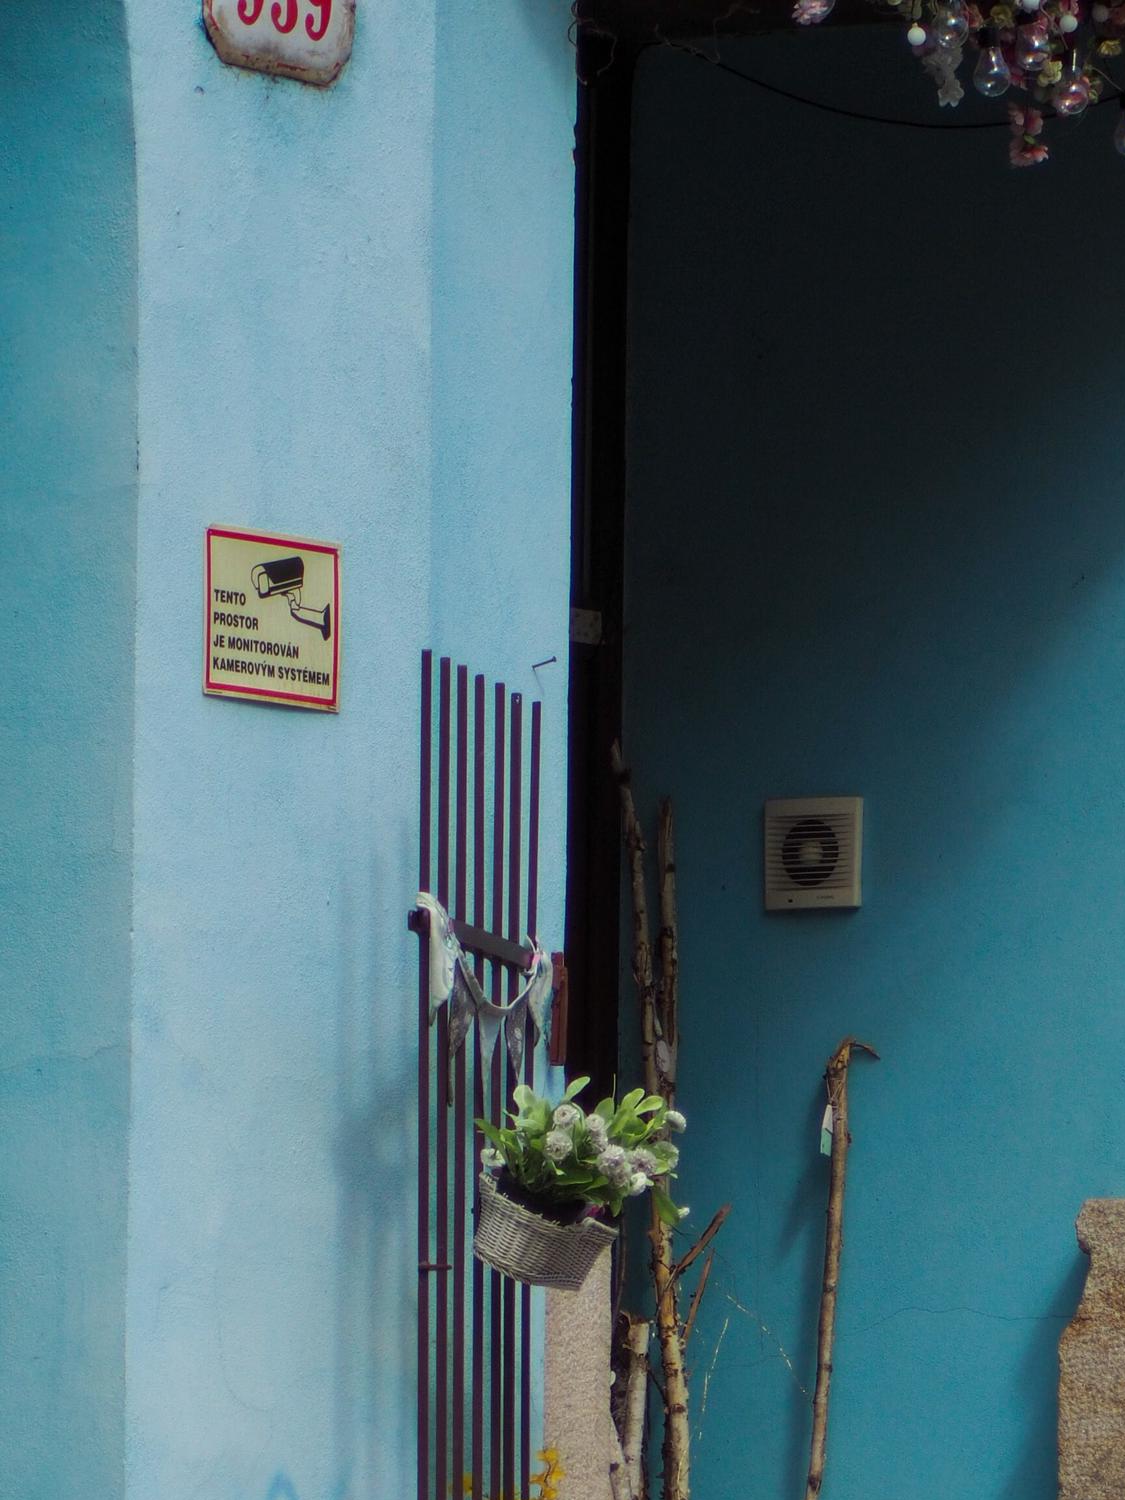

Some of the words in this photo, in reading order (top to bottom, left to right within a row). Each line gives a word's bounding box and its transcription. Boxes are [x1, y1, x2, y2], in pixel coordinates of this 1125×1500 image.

[213, 589, 246, 606] TENTO
[213, 611, 259, 631] PROSTOR
[213, 635, 225, 648] JE
[228, 637, 299, 659] MONITOROVÁN
[213, 656, 275, 678] KAMEROVÝM
[278, 666, 330, 686] SYSTÉMEM
